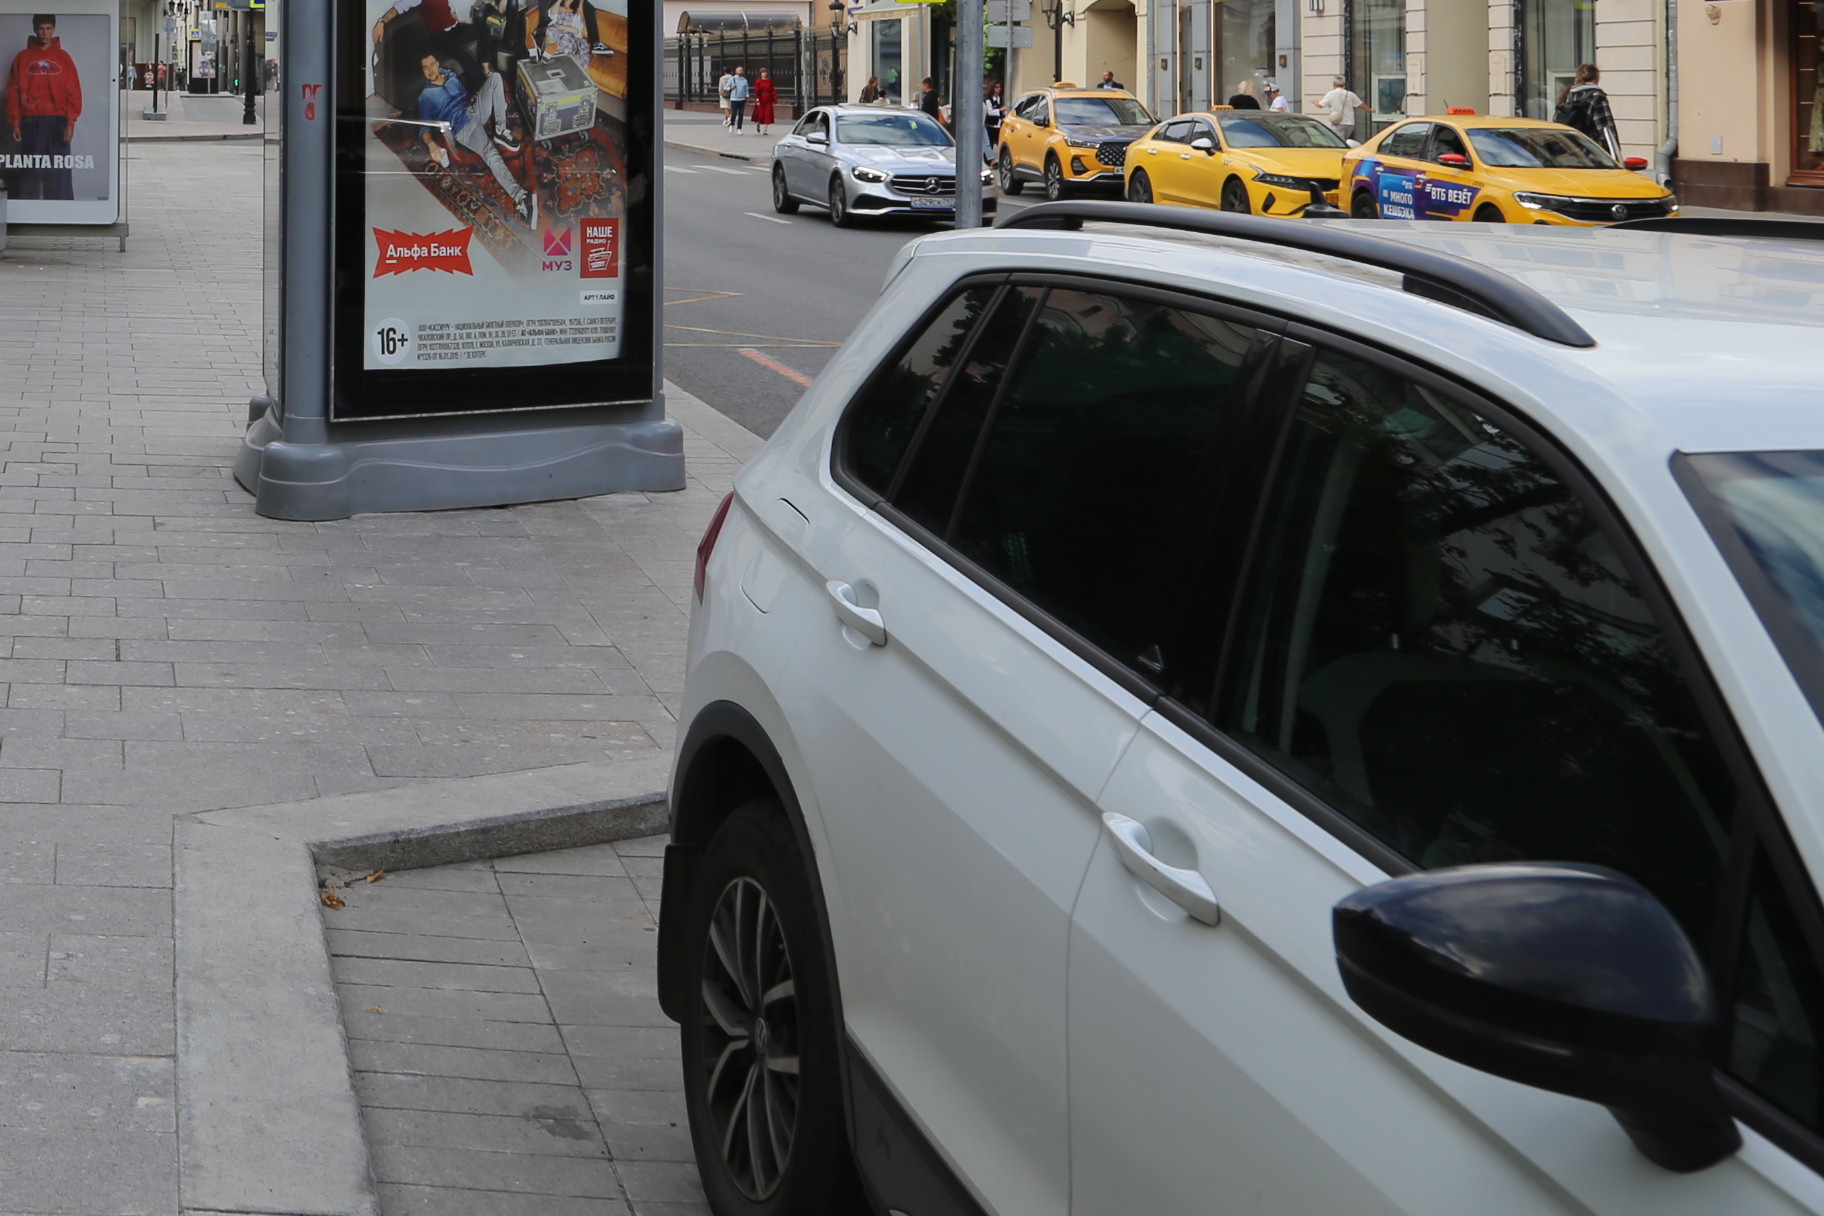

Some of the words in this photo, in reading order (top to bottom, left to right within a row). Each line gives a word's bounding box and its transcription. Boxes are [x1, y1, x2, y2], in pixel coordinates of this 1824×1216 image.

[54, 154, 94, 169] ROSA
[1390, 191, 1413, 205] МНОГО
[1431, 187, 1446, 200] ВТБ
[1448, 188, 1472, 204] ВЕЗЁТ
[586, 226, 613, 238] НАШЕ
[386, 243, 428, 262] Альфа
[431, 242, 462, 257] Банк
[542, 260, 573, 271] МУЗ
[377, 327, 408, 355] 16+
